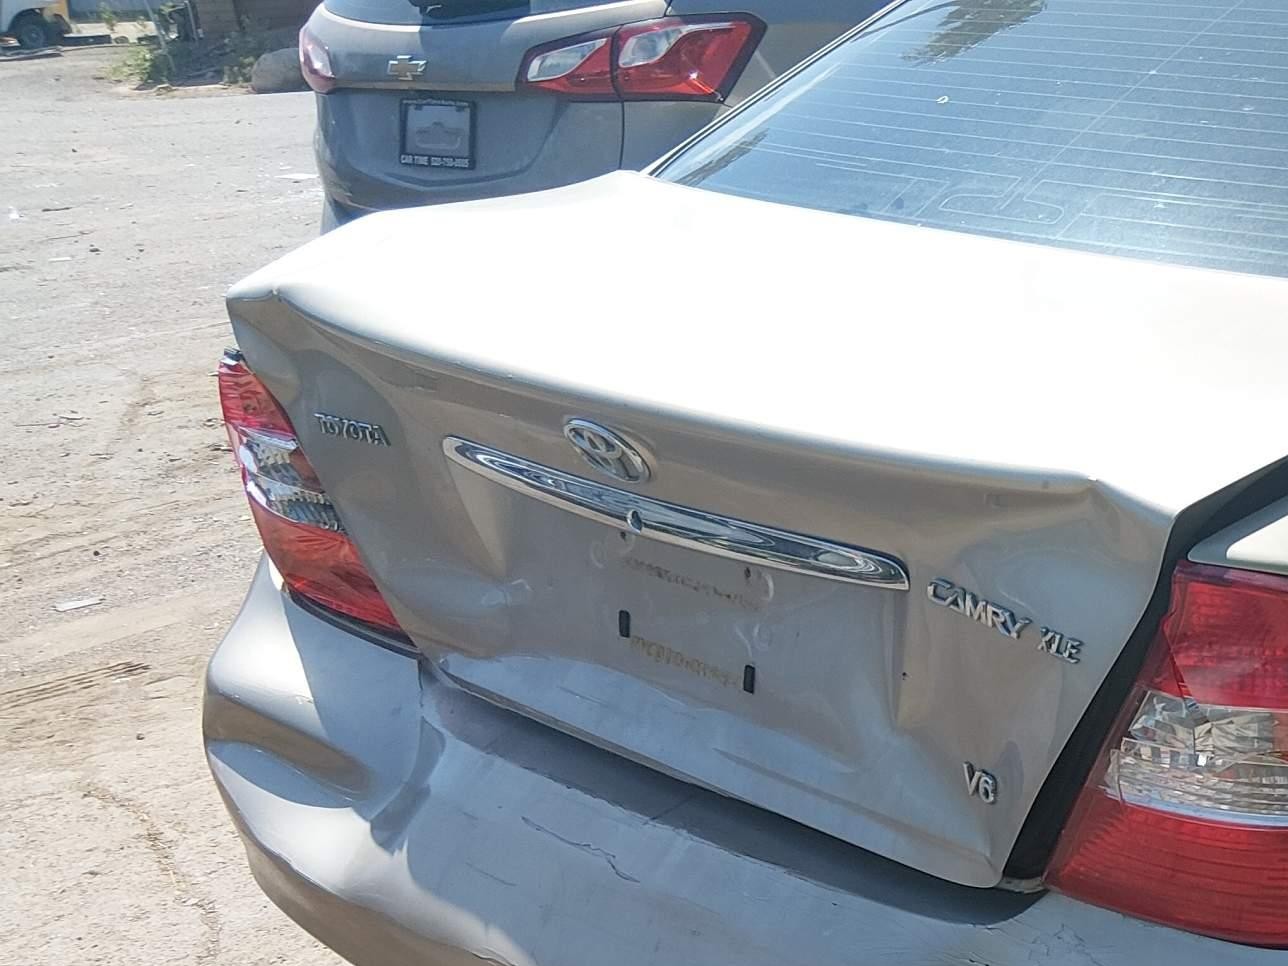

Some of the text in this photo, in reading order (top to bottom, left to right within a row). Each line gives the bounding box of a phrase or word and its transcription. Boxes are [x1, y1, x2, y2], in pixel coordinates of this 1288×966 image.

[313, 412, 391, 447] TOYOTA
[927, 577, 1085, 664] CAMRY XLE
[963, 761, 997, 805] V6
